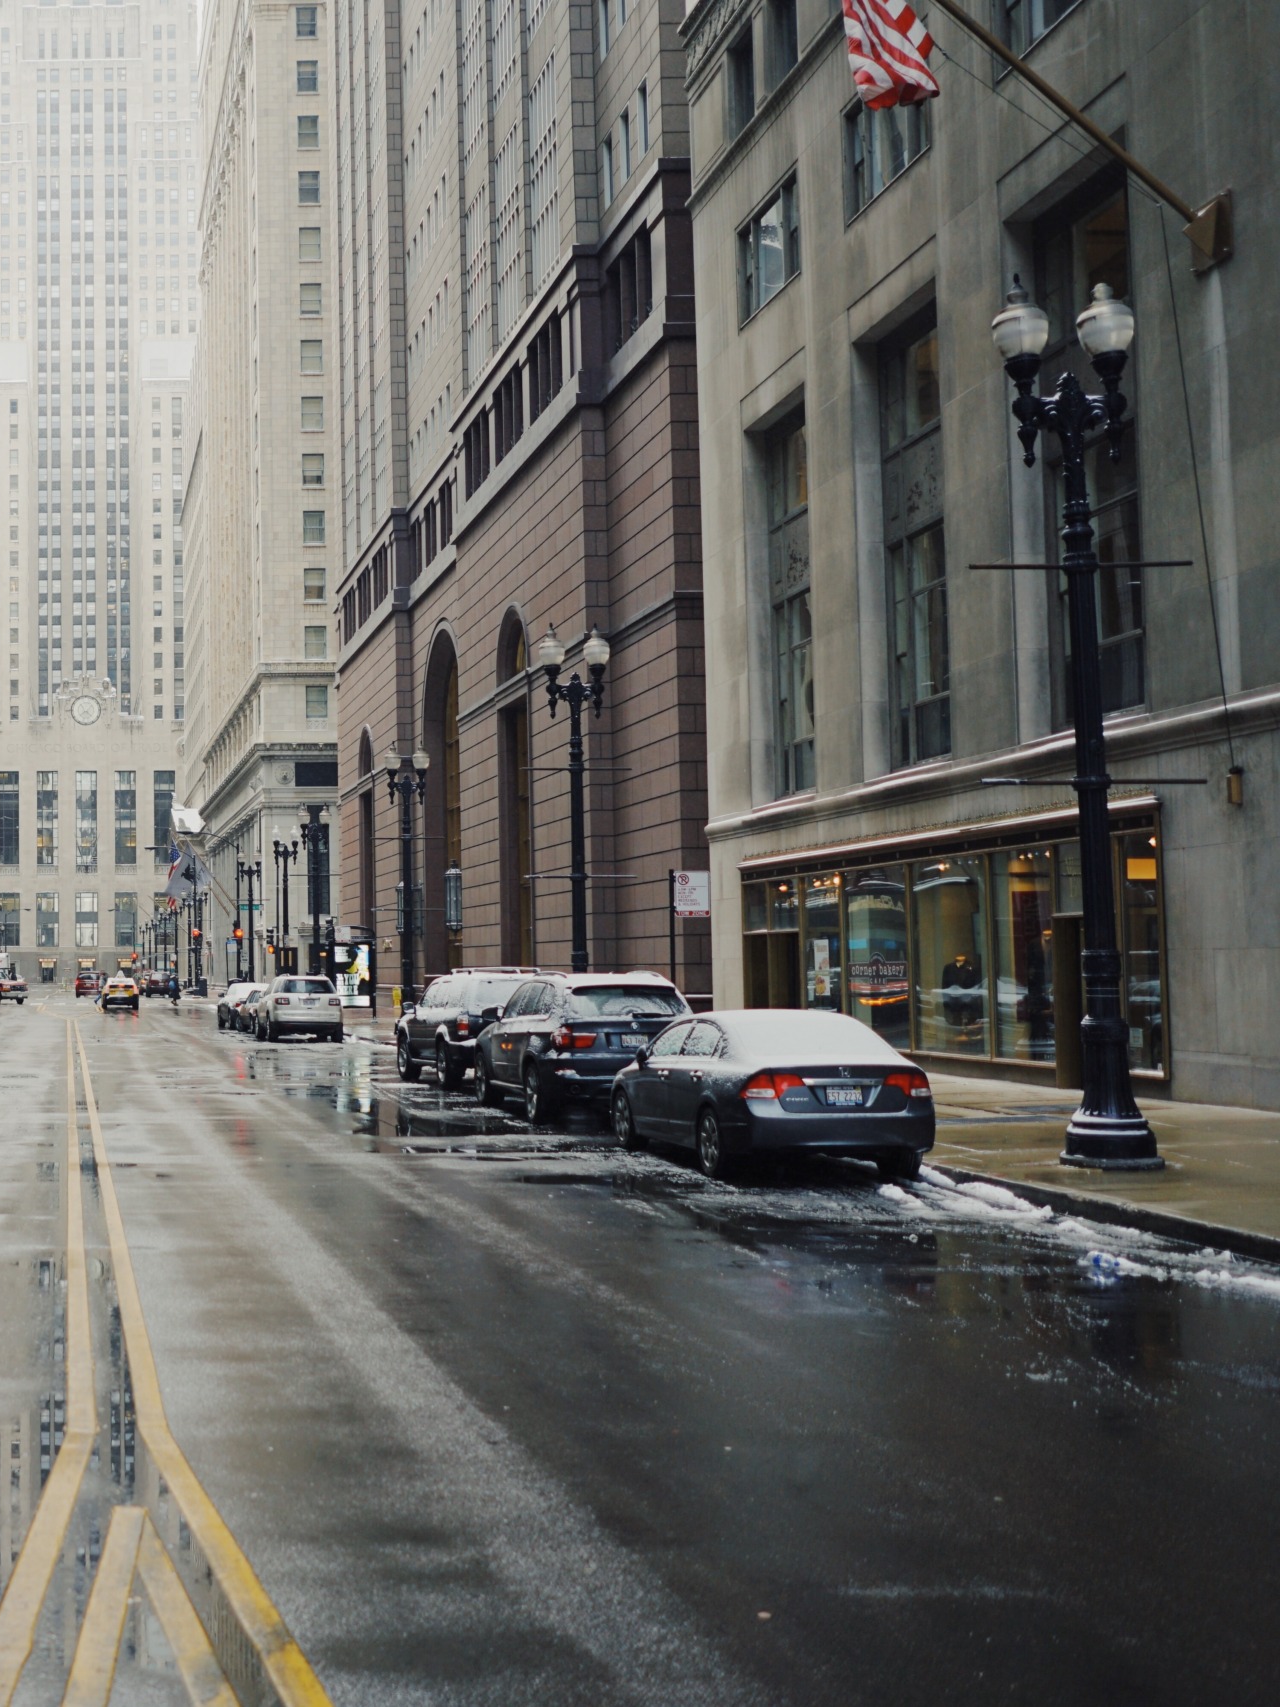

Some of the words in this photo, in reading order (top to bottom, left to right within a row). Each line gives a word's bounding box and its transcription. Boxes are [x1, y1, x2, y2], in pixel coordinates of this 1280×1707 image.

[6, 743, 61, 754] CHICAGO
[66, 743, 106, 754] BOARD
[110, 743, 128, 753] OF
[131, 743, 169, 753] TRADE
[851, 964, 877, 976] corner
[879, 963, 905, 976] bakery
